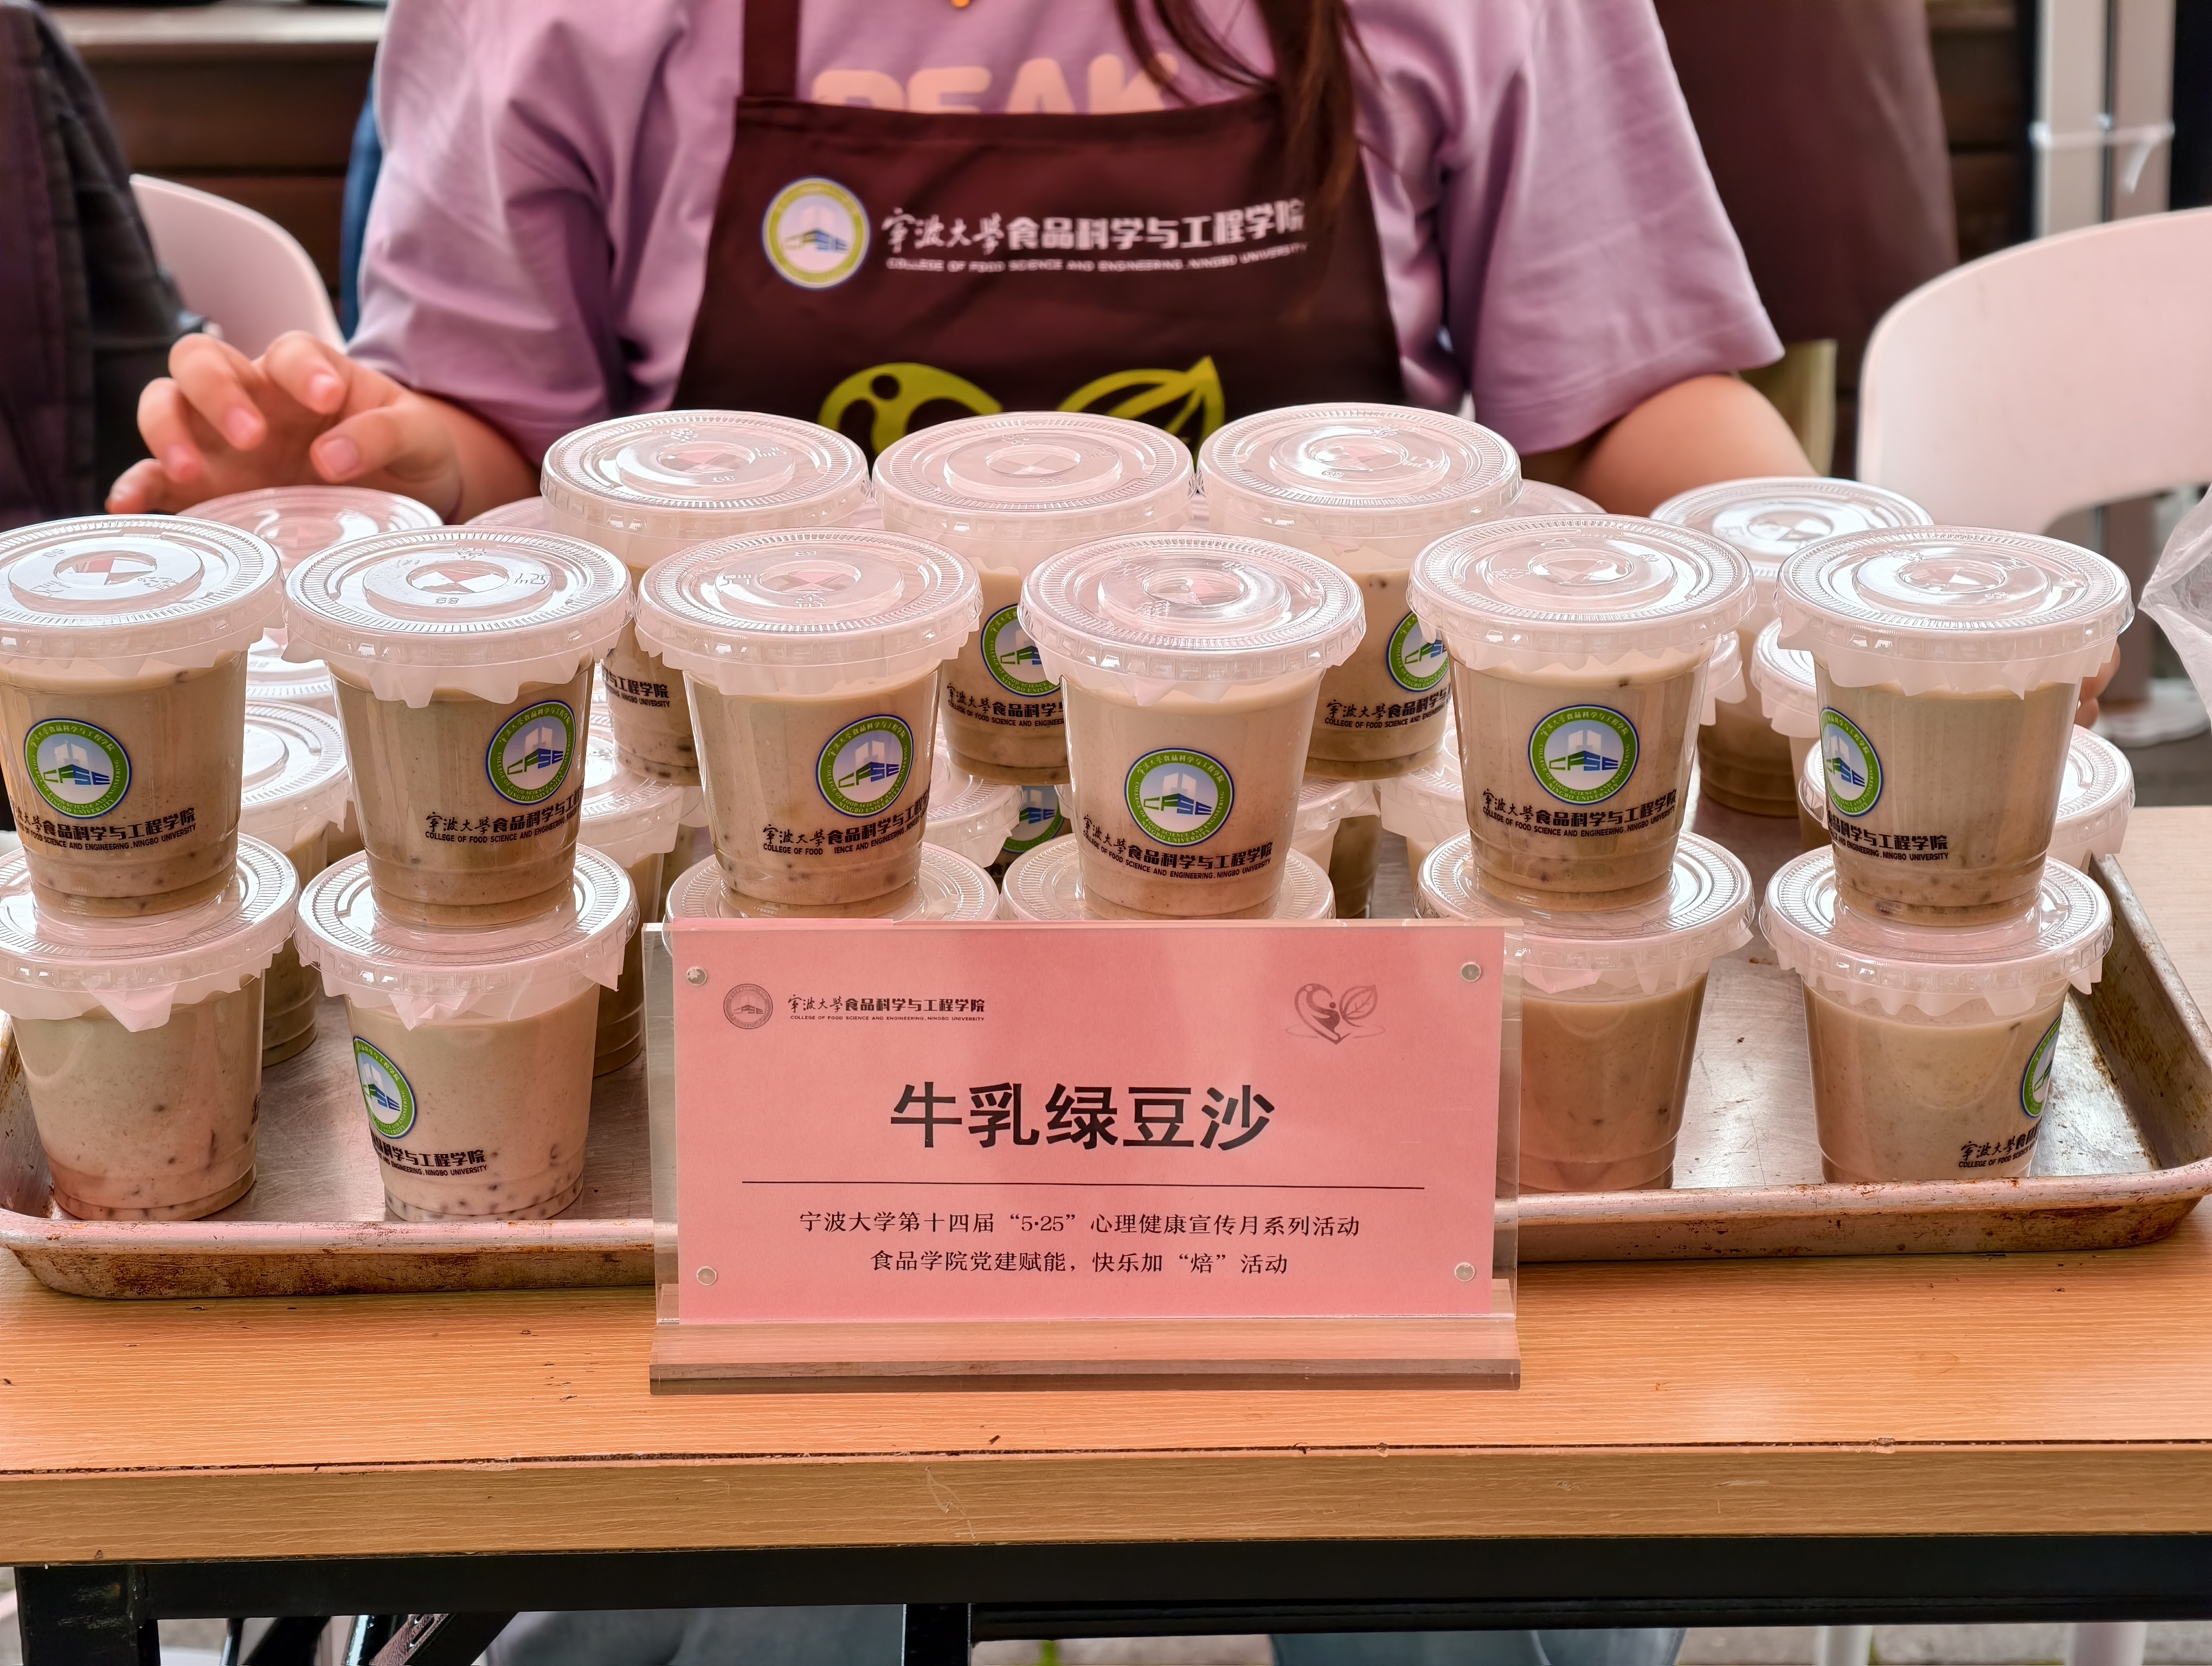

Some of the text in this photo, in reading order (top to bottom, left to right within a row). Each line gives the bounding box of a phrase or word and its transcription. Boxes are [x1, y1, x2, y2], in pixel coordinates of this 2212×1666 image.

[639, 698, 670, 707] UNIVERSITY
[975, 713, 989, 722] FOOD
[992, 717, 1016, 726] SCIENCE
[1325, 717, 1353, 727] COLLEGE
[1385, 719, 1408, 727] SCIENCE
[1410, 715, 1420, 723] AND
[1483, 806, 1503, 823] COLLEGE
[1506, 817, 1513, 825] OF
[1515, 822, 1531, 831] FOOD
[1534, 826, 1561, 836] SCIENCE
[1627, 820, 1649, 832] NINGBO
[1651, 805, 1675, 825] UNIVERSITY
[44, 836, 67, 848] SCIENCE
[133, 838, 158, 848] NINGBO
[162, 824, 196, 842] UNIVERSITY
[425, 831, 454, 842] COLLEGE
[490, 834, 517, 842] SCIENCE
[520, 830, 532, 840] AND
[763, 843, 791, 854] COLLEGE
[856, 843, 869, 851] AND
[1083, 831, 1099, 849] COLLEGE
[1101, 846, 1107, 854] OF
[1109, 851, 1123, 863] FOOD
[1126, 860, 1150, 873] SCIENCE
[1217, 869, 1239, 879] NINGBO
[1243, 857, 1271, 874] UNIVERSITY
[1883, 851, 1906, 860] NINGBO
[1909, 853, 1948, 861] UNIVERSITY
[890, 1081, 1275, 1151] 牛乳绿豆沙
[1998, 1155, 2011, 1164] FOOD
[451, 1164, 486, 1176] UNIVERSITY
